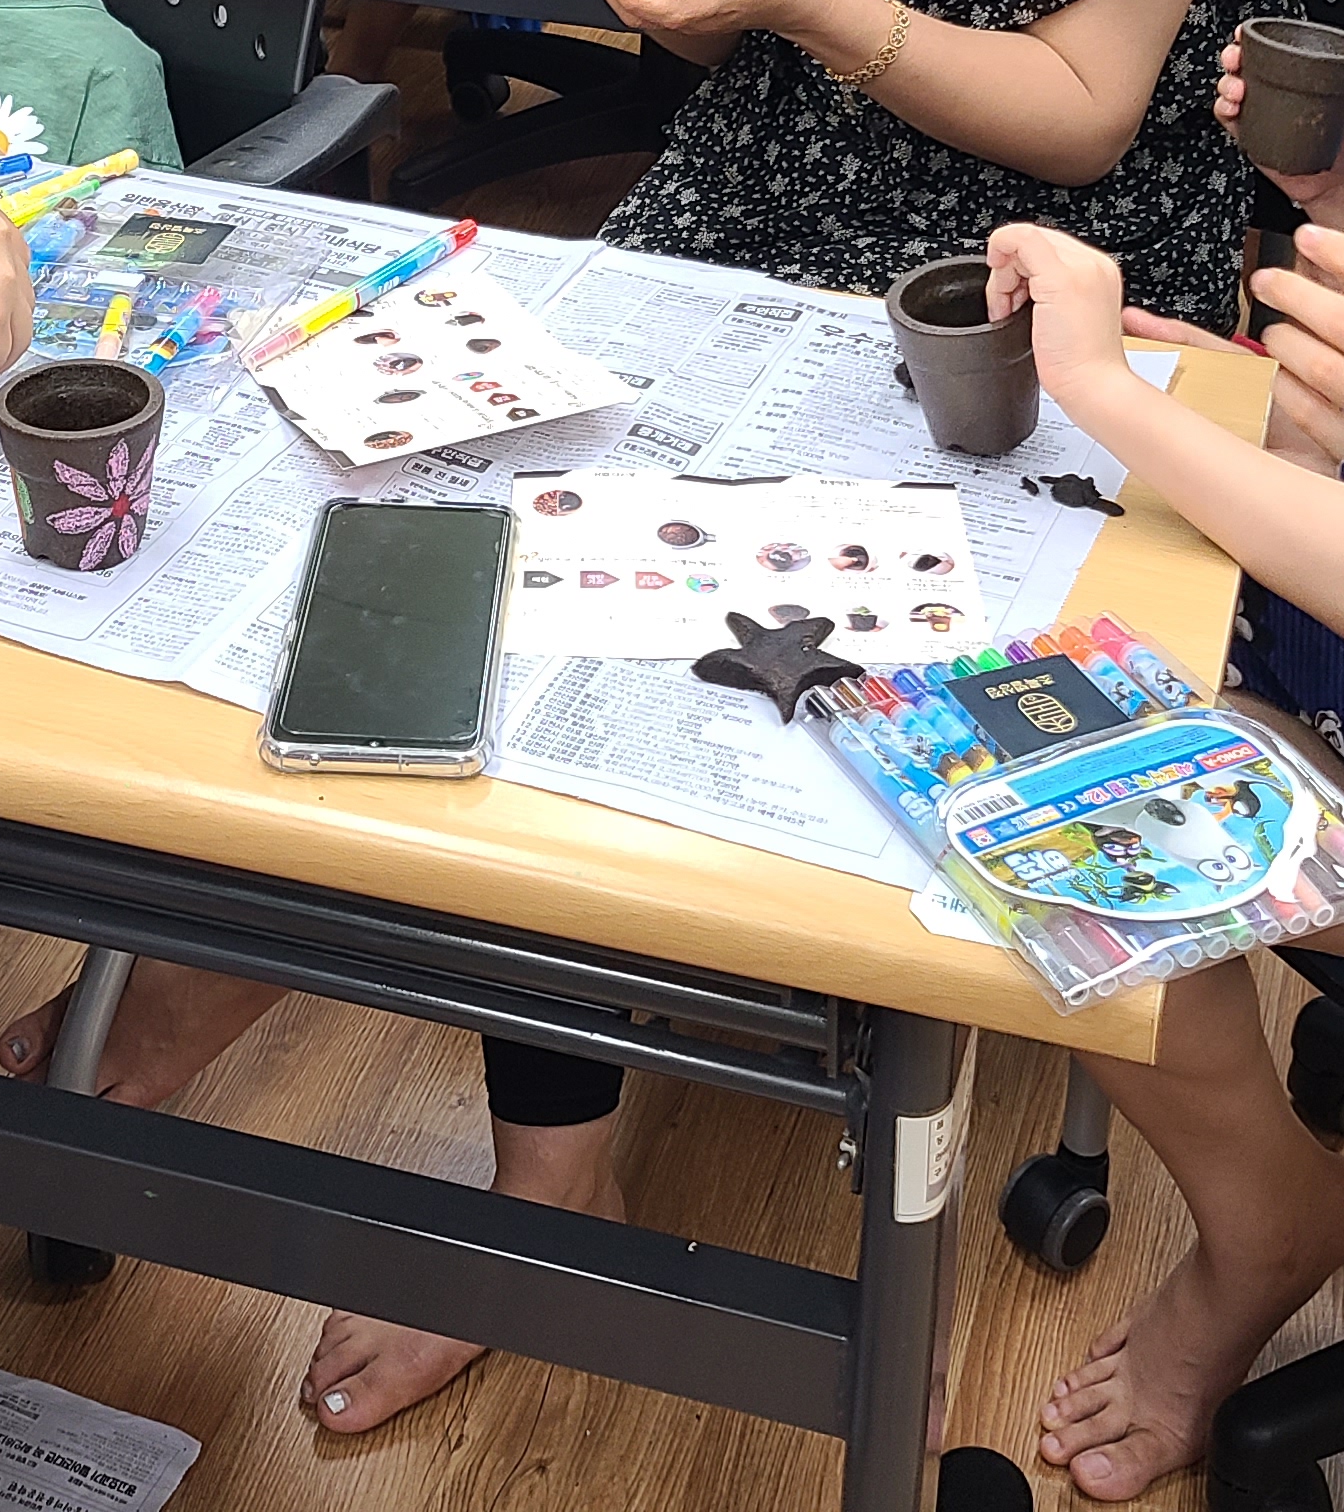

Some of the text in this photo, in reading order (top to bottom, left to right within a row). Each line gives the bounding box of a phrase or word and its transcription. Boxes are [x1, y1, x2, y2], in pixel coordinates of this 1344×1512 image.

[985, 672, 1056, 701] 초록별상점
[1203, 745, 1254, 768] DONG-A
[44, 1451, 90, 1478] 떨어진다면
[90, 1470, 138, 1497] 광고효과가
